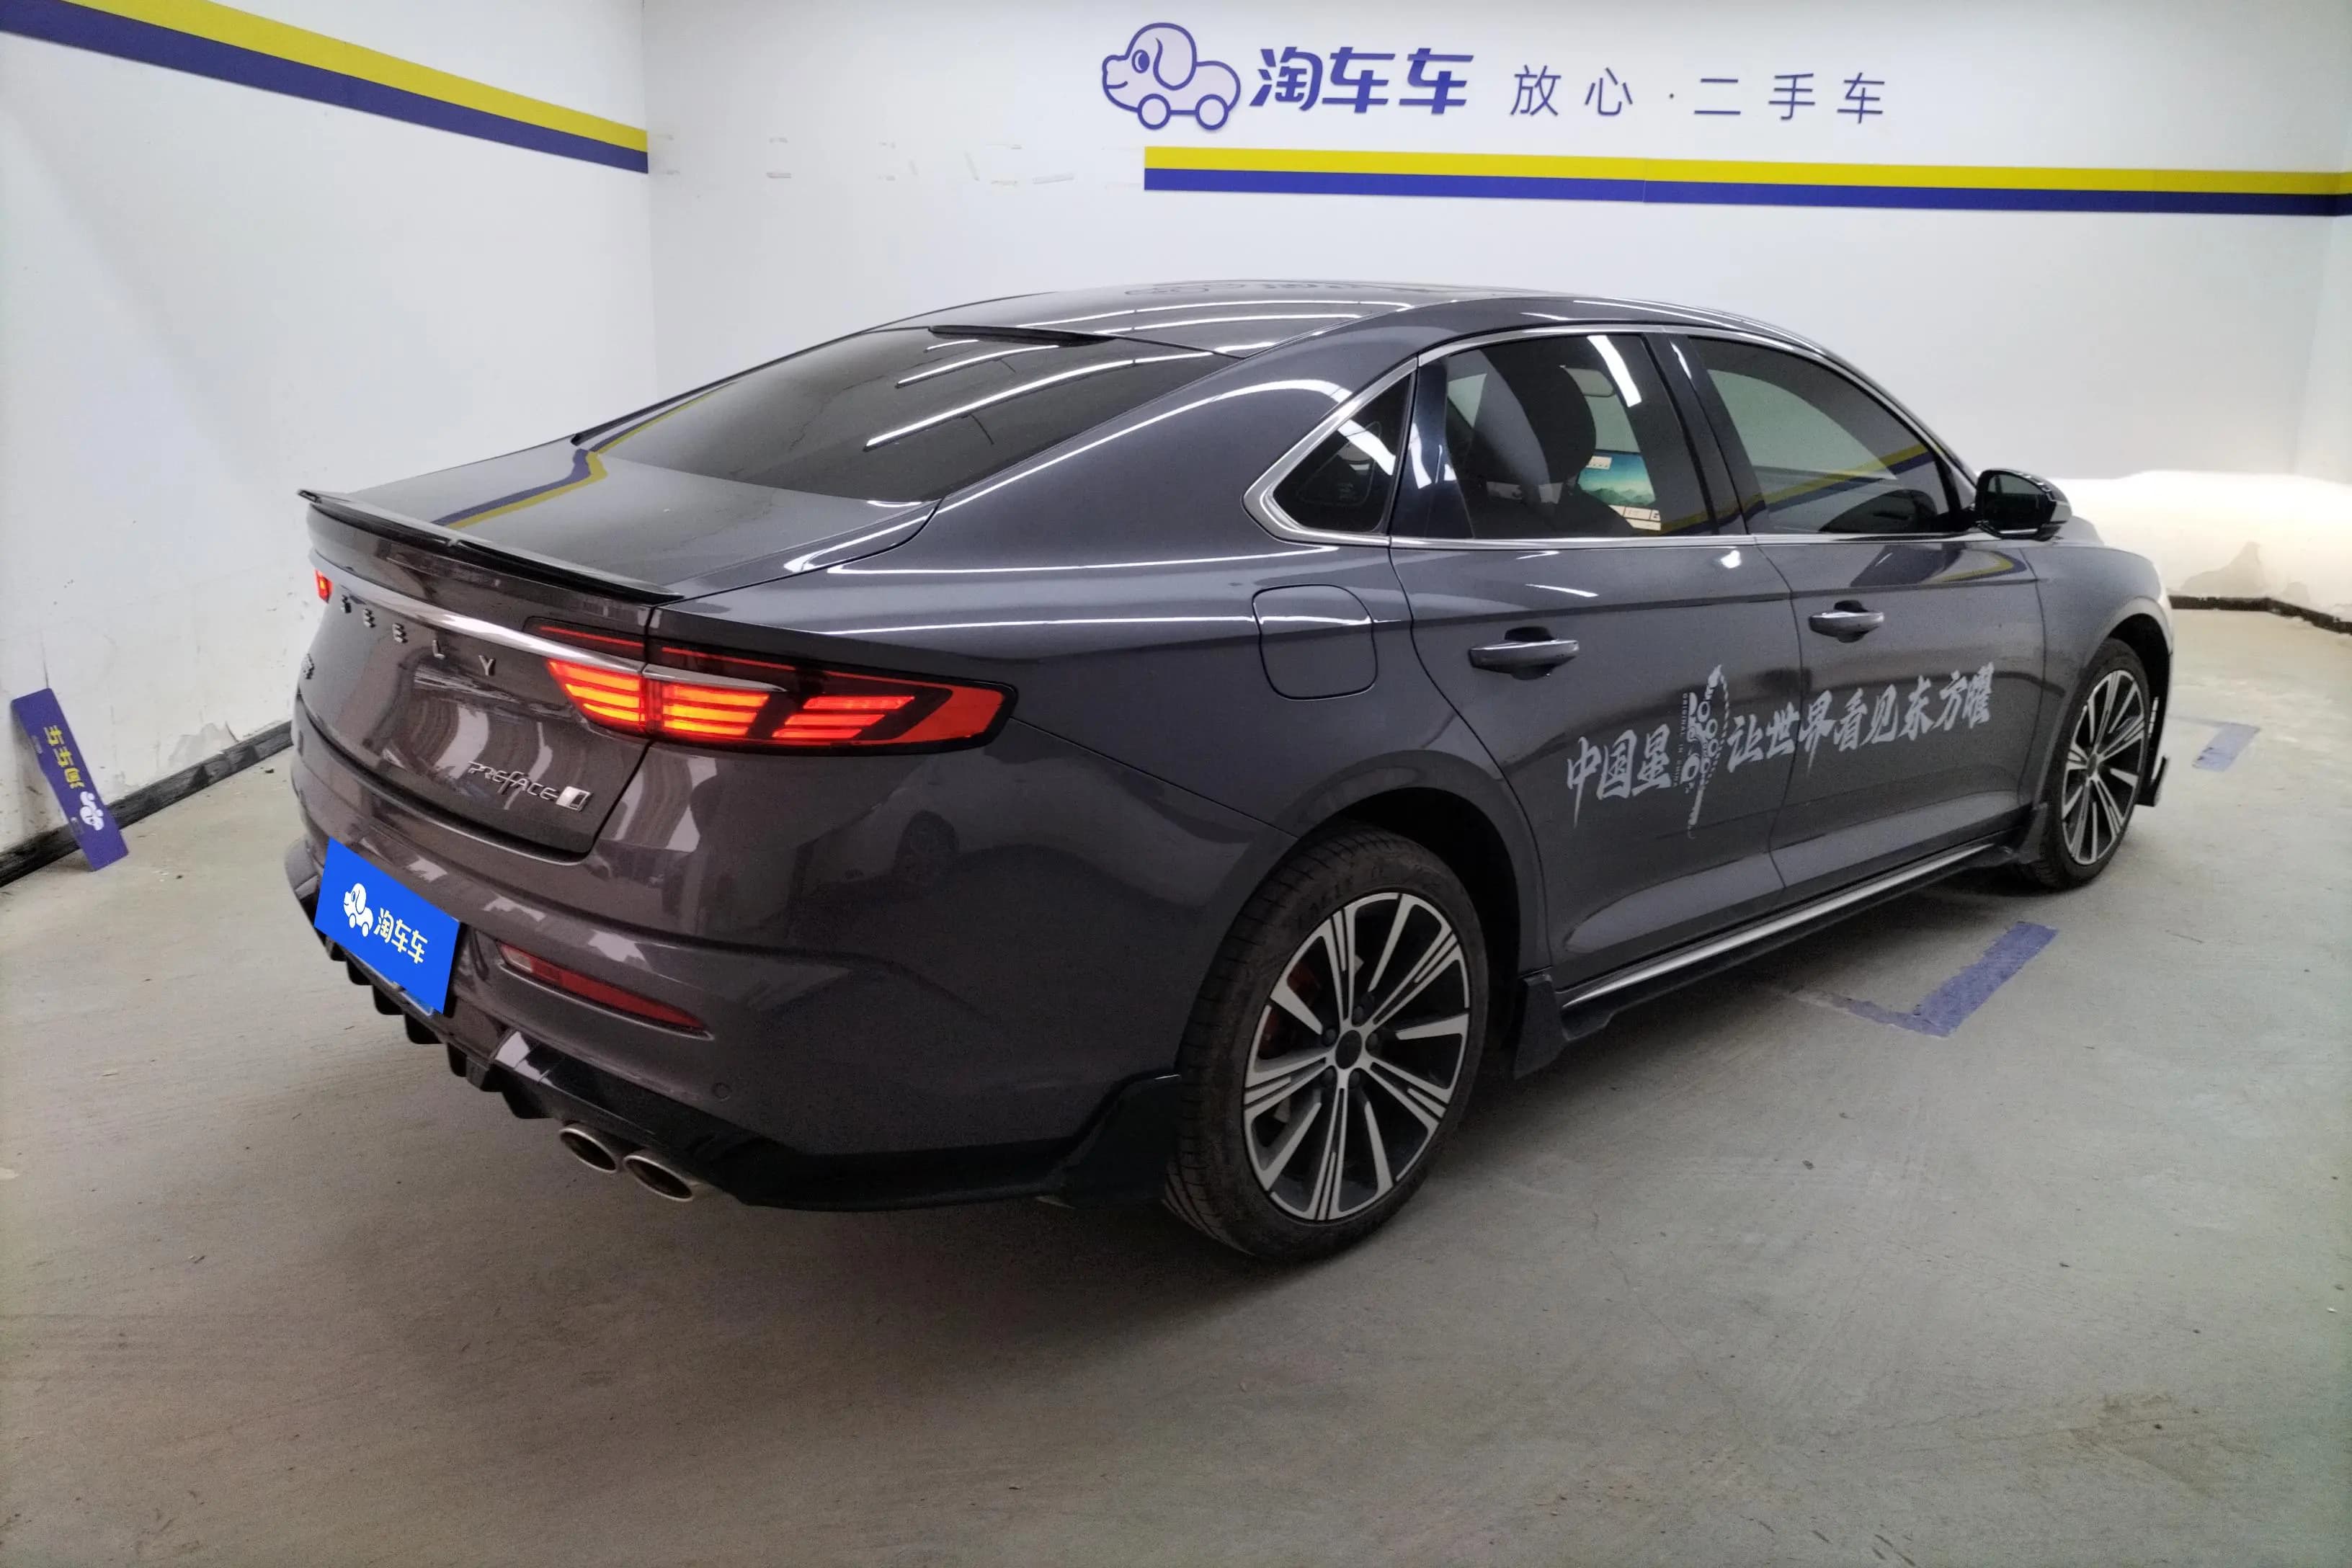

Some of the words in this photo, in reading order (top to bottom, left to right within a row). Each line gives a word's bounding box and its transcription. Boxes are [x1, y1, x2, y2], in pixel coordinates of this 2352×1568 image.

[1250, 46, 1474, 115] 淘车车
[1567, 723, 1672, 829] 中国星
